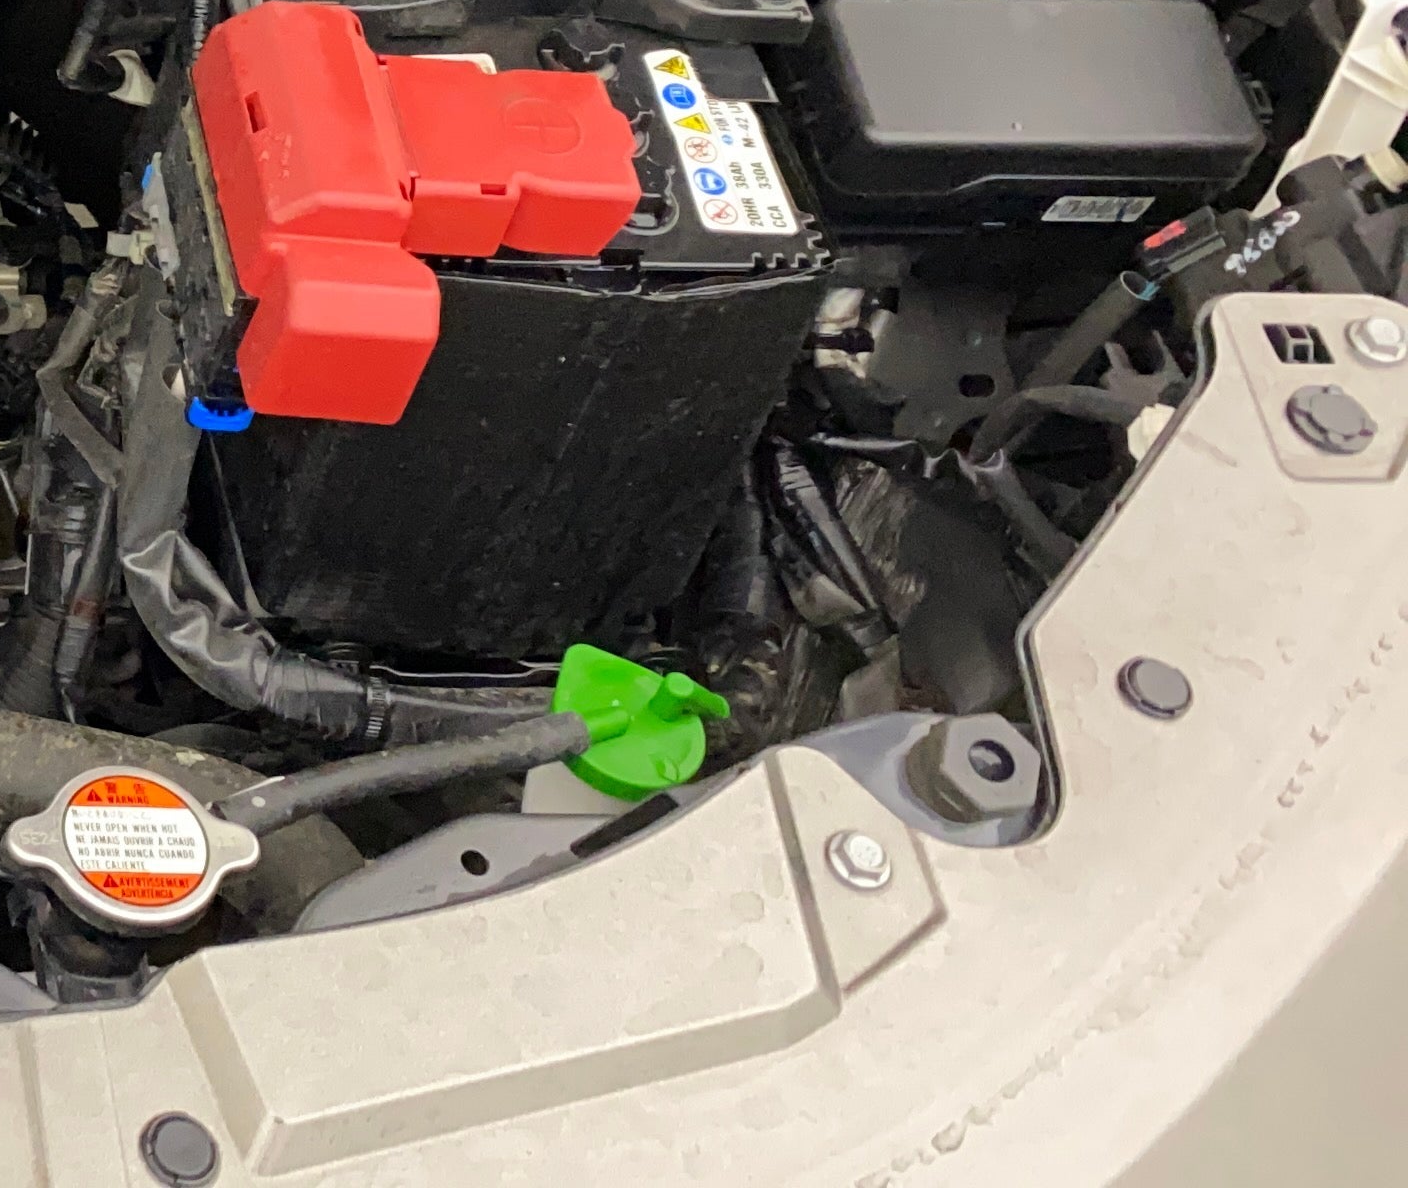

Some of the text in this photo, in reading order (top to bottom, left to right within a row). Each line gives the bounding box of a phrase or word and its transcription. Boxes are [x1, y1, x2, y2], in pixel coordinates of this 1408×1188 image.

[728, 161, 764, 228] 20HR 38Ah
[751, 162, 787, 229] CCA 330A
[106, 795, 151, 805] WARNING
[73, 821, 179, 834] NEVER OPEN WHEN HOT
[75, 834, 86, 845] NE
[90, 835, 121, 845] JAMAIS
[123, 835, 154, 846] OUVRIR
[167, 836, 196, 847] CHAUD
[78, 846, 196, 860] NO ABRIR NUNCA CUANDO
[80, 859, 146, 871] ESTE CALIENTE
[119, 876, 190, 889] AVERTISSEMENT
[120, 887, 174, 899] ADVERTENCIA
